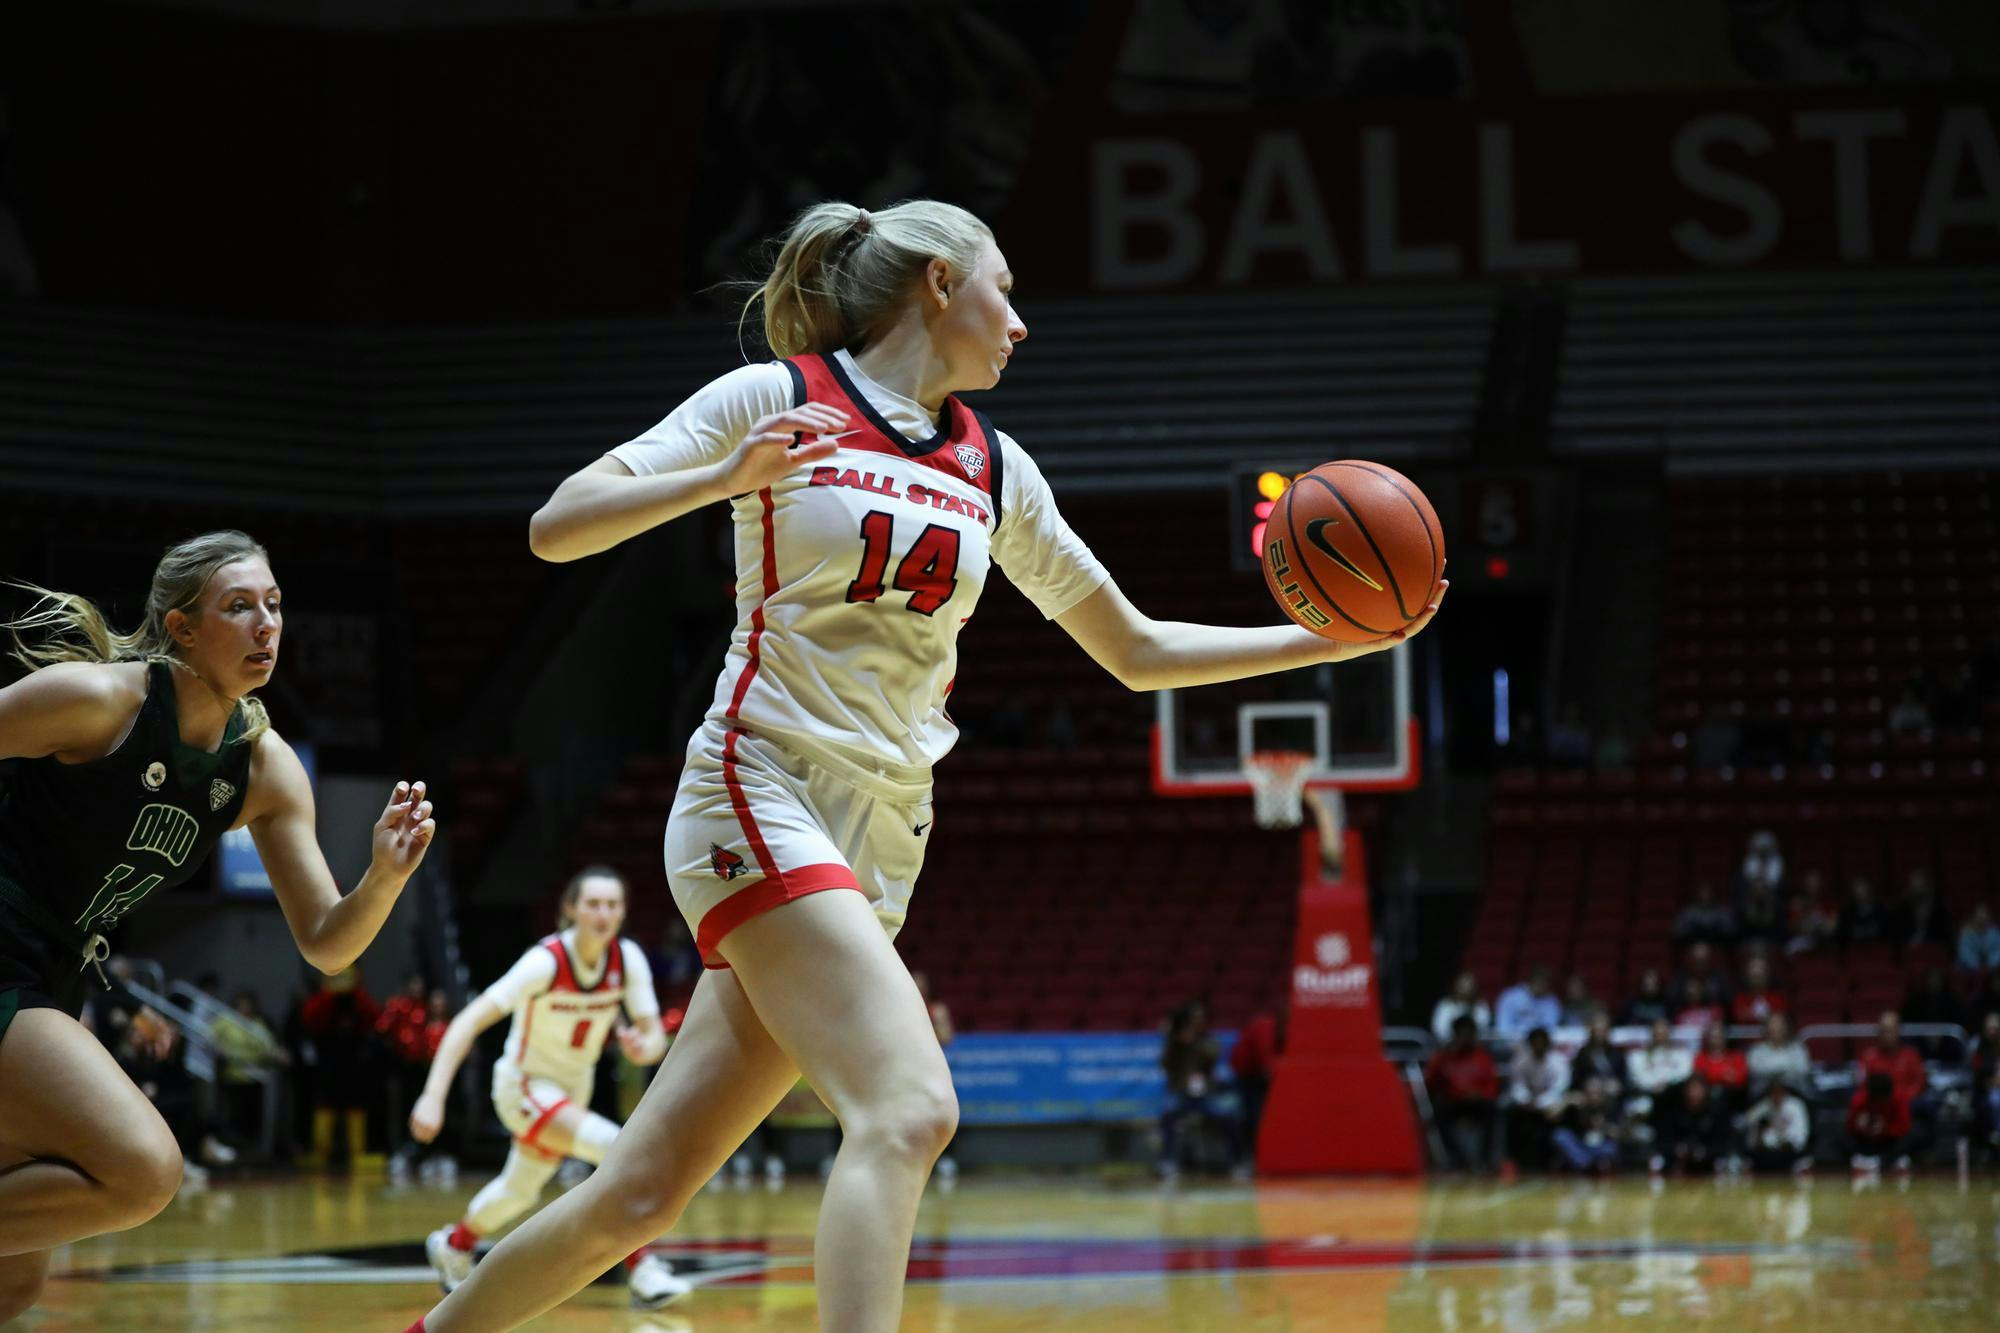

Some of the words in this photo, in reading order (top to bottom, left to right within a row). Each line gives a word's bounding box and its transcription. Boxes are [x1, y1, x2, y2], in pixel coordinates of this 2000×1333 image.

[1088, 121, 1581, 290] BALL
[1668, 105, 2000, 264] STA
[809, 466, 901, 499] BALL
[845, 509, 961, 618] 14
[1269, 537, 1334, 630] ELITE
[126, 803, 200, 868] OHIO
